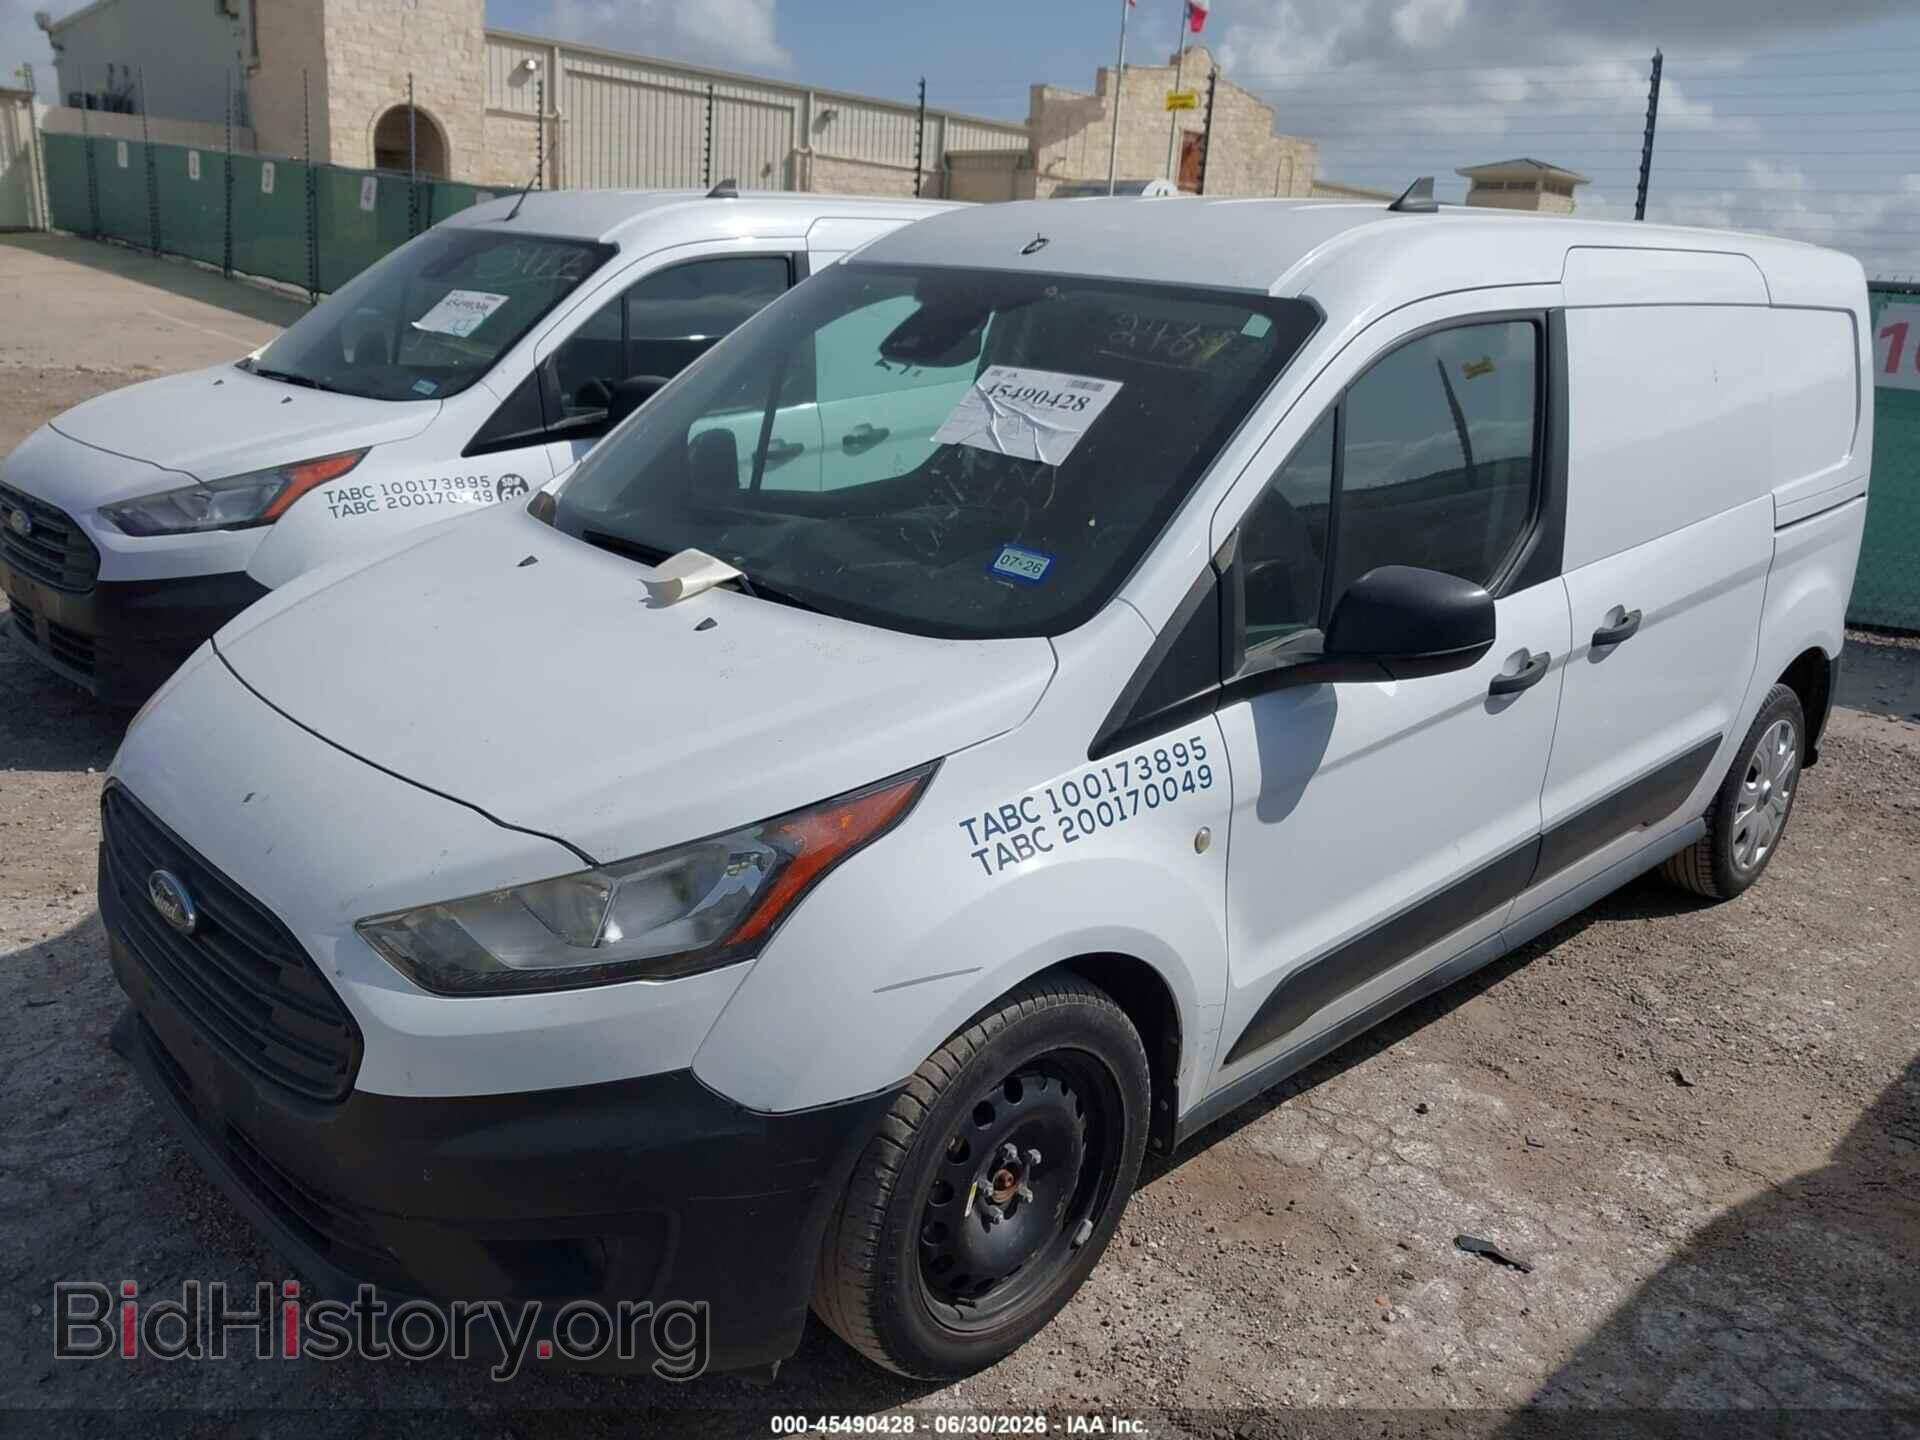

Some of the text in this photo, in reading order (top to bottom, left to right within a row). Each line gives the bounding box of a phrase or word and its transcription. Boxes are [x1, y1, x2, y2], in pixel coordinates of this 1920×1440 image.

[1880, 321, 1920, 375] 1
[324, 475, 491, 504] TABC 100173895
[328, 490, 494, 519] TABC 20017049
[959, 735, 1207, 846] TABC 100173895
[971, 764, 1213, 876] TABC 200170049
